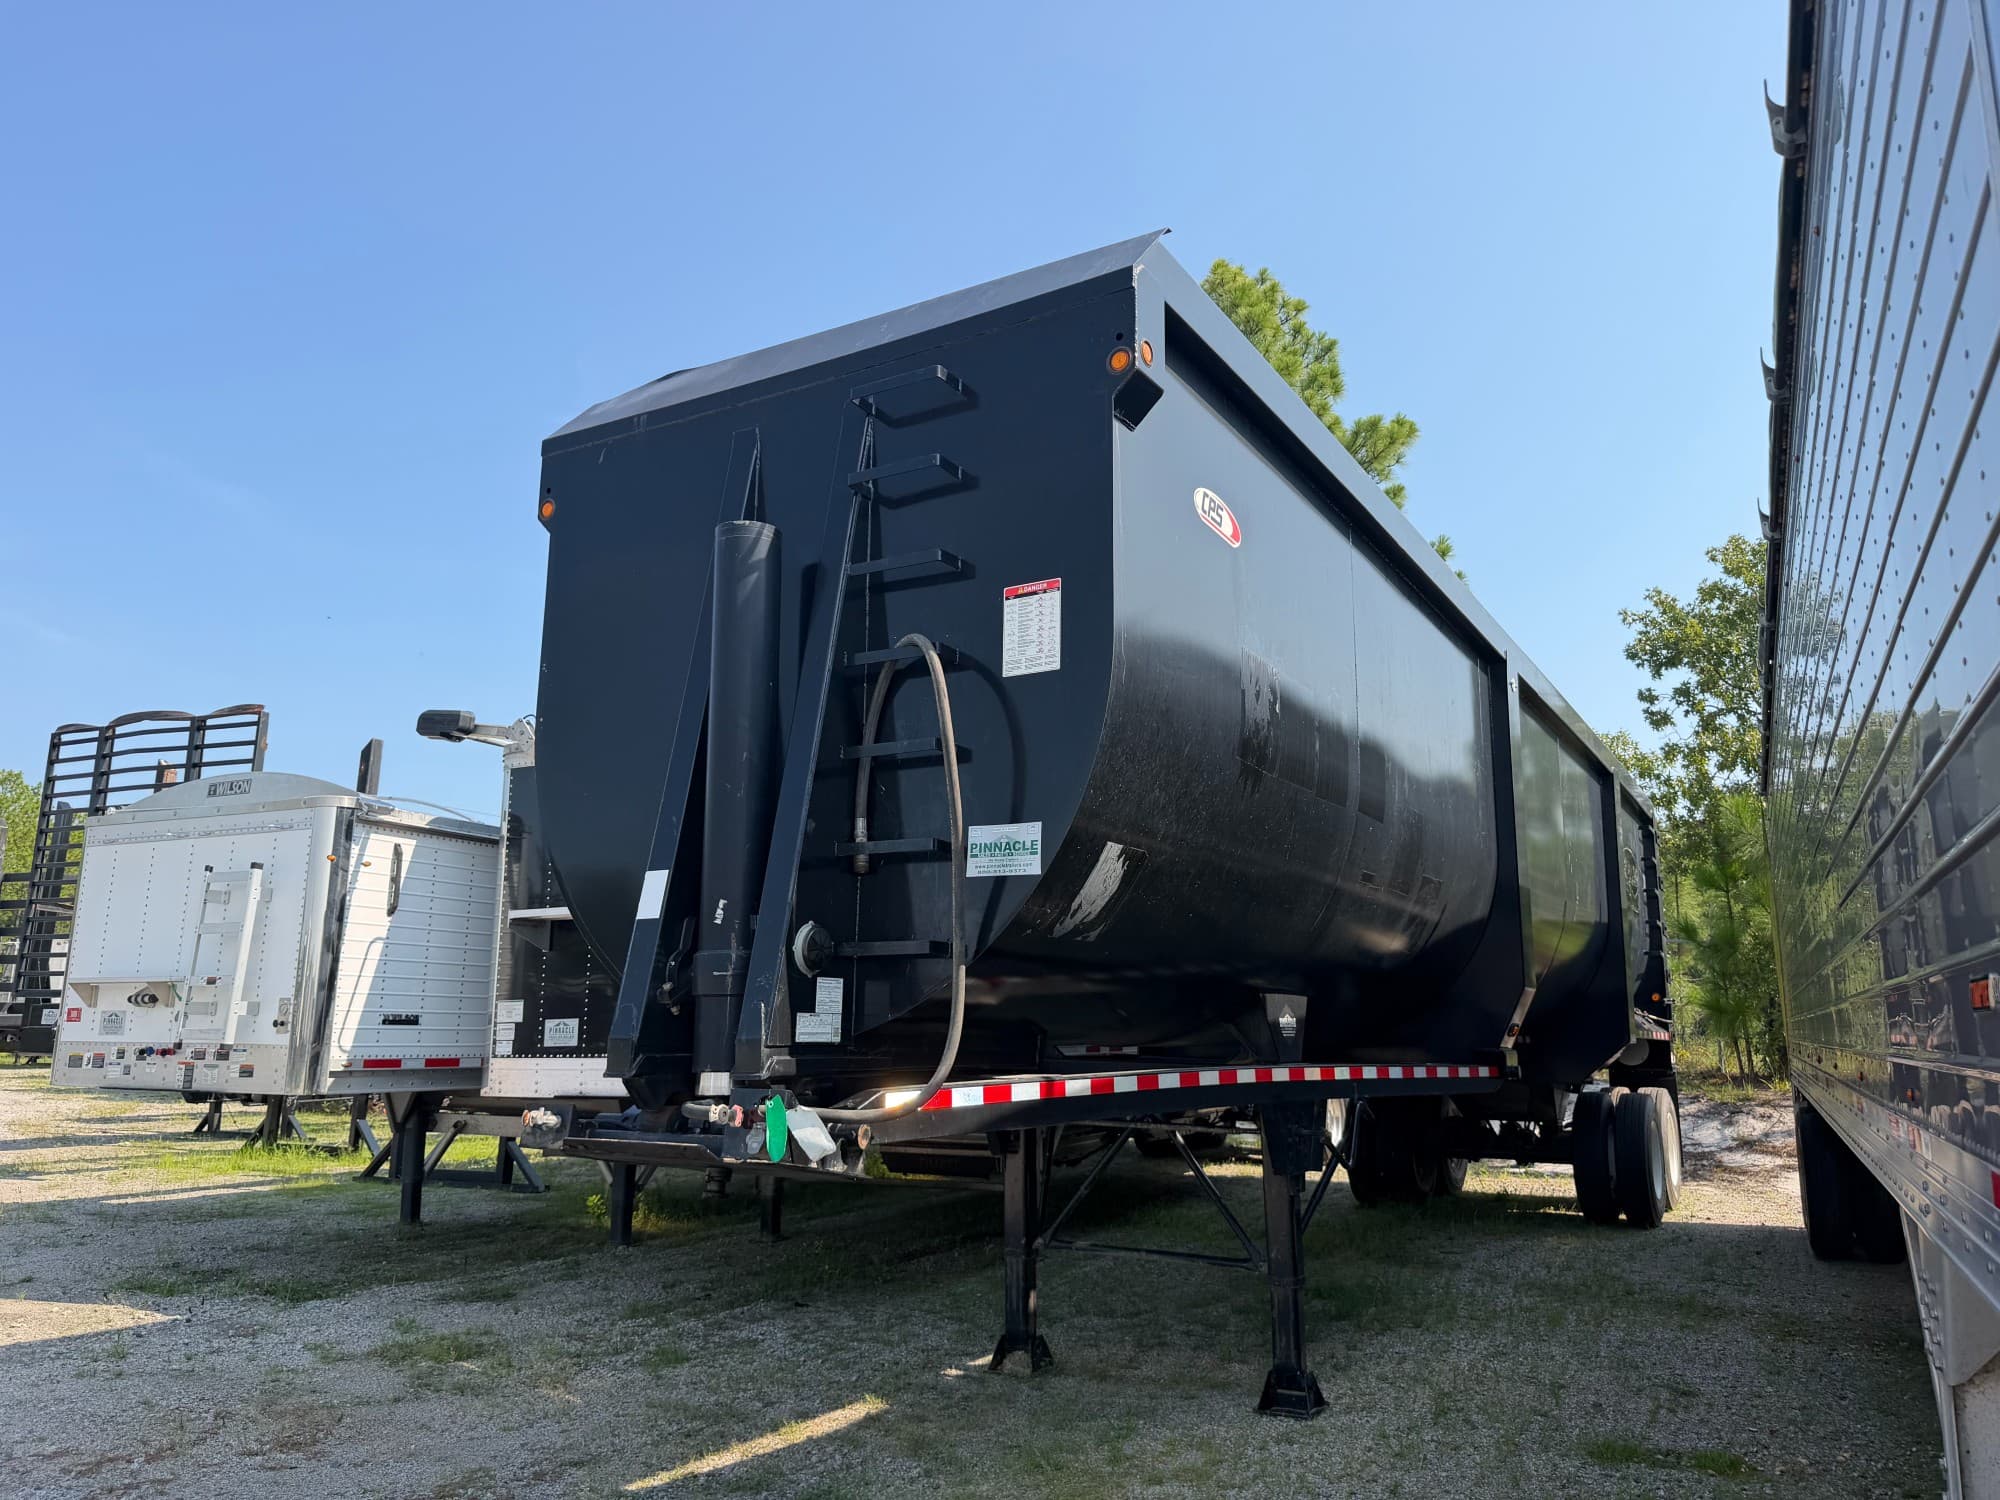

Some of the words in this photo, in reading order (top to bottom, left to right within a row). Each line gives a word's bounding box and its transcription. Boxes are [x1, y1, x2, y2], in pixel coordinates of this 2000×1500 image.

[1201, 491, 1223, 528] CPS
[216, 780, 251, 796] WILSON
[970, 840, 1039, 854] PINNACLE
